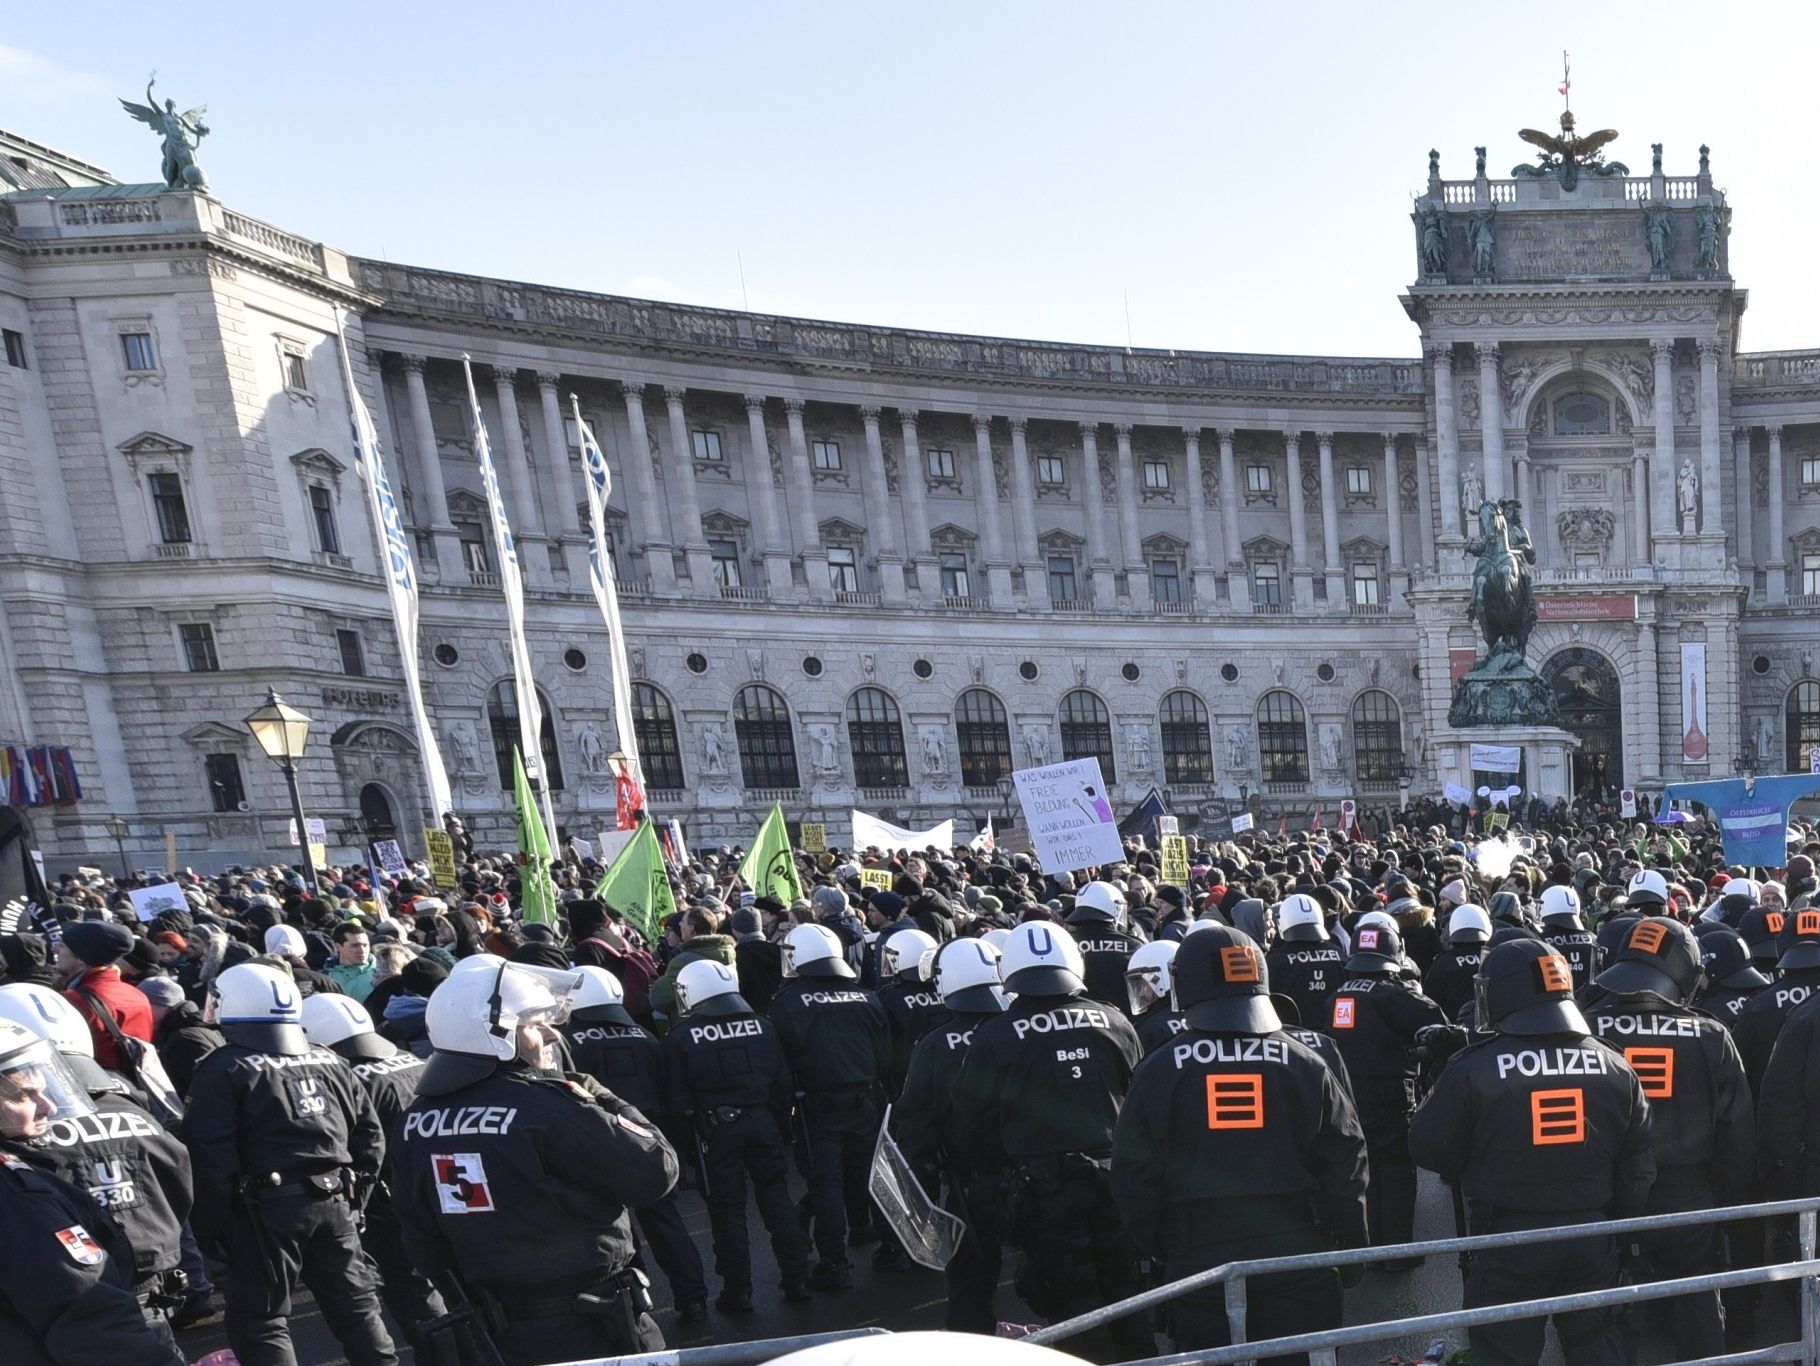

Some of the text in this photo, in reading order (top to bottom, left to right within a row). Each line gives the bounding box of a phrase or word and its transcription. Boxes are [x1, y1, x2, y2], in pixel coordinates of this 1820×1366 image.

[1020, 767, 1065, 784] WAS WOLLEN
[1029, 784, 1060, 799] FREIE
[1034, 797, 1071, 815] BILDUNG
[1037, 818, 1086, 834] WANN WOLLEN
[1054, 845, 1096, 865] IMMER
[864, 871, 889, 883] LASST
[1635, 871, 1647, 885] U
[1297, 897, 1313, 914] U
[1564, 891, 1576, 907] U
[1027, 928, 1053, 956] U
[1076, 939, 1129, 953] OLIZEI
[1360, 934, 1376, 944] EA
[1544, 933, 1592, 947] POLIZEI
[1286, 949, 1341, 965] POLIZEI
[1570, 952, 1580, 963] U
[713, 963, 733, 982] U
[1314, 969, 1323, 981] U
[270, 979, 293, 1009] U
[1308, 981, 1326, 991] 340
[800, 990, 869, 1007] POLIZEI
[1336, 1007, 1350, 1020] EA
[690, 1018, 763, 1045] POLIZEI
[1012, 1008, 1111, 1040] POLIZEI
[1597, 1014, 1701, 1038] POLIZEI
[572, 1025, 648, 1045] POLIZEI
[1056, 1047, 1090, 1062] BeSi
[1173, 1037, 1289, 1070] POLIZEI
[1496, 1047, 1609, 1080] POLIZEI
[1071, 1066, 1082, 1079] 3
[300, 1079, 316, 1095] U
[299, 1096, 325, 1114] 330
[50, 1111, 160, 1148] OLIZEI
[403, 1105, 518, 1142] POLIZEI
[95, 1160, 122, 1186] U
[446, 1165, 474, 1202] 5
[91, 1185, 135, 1208] 330
